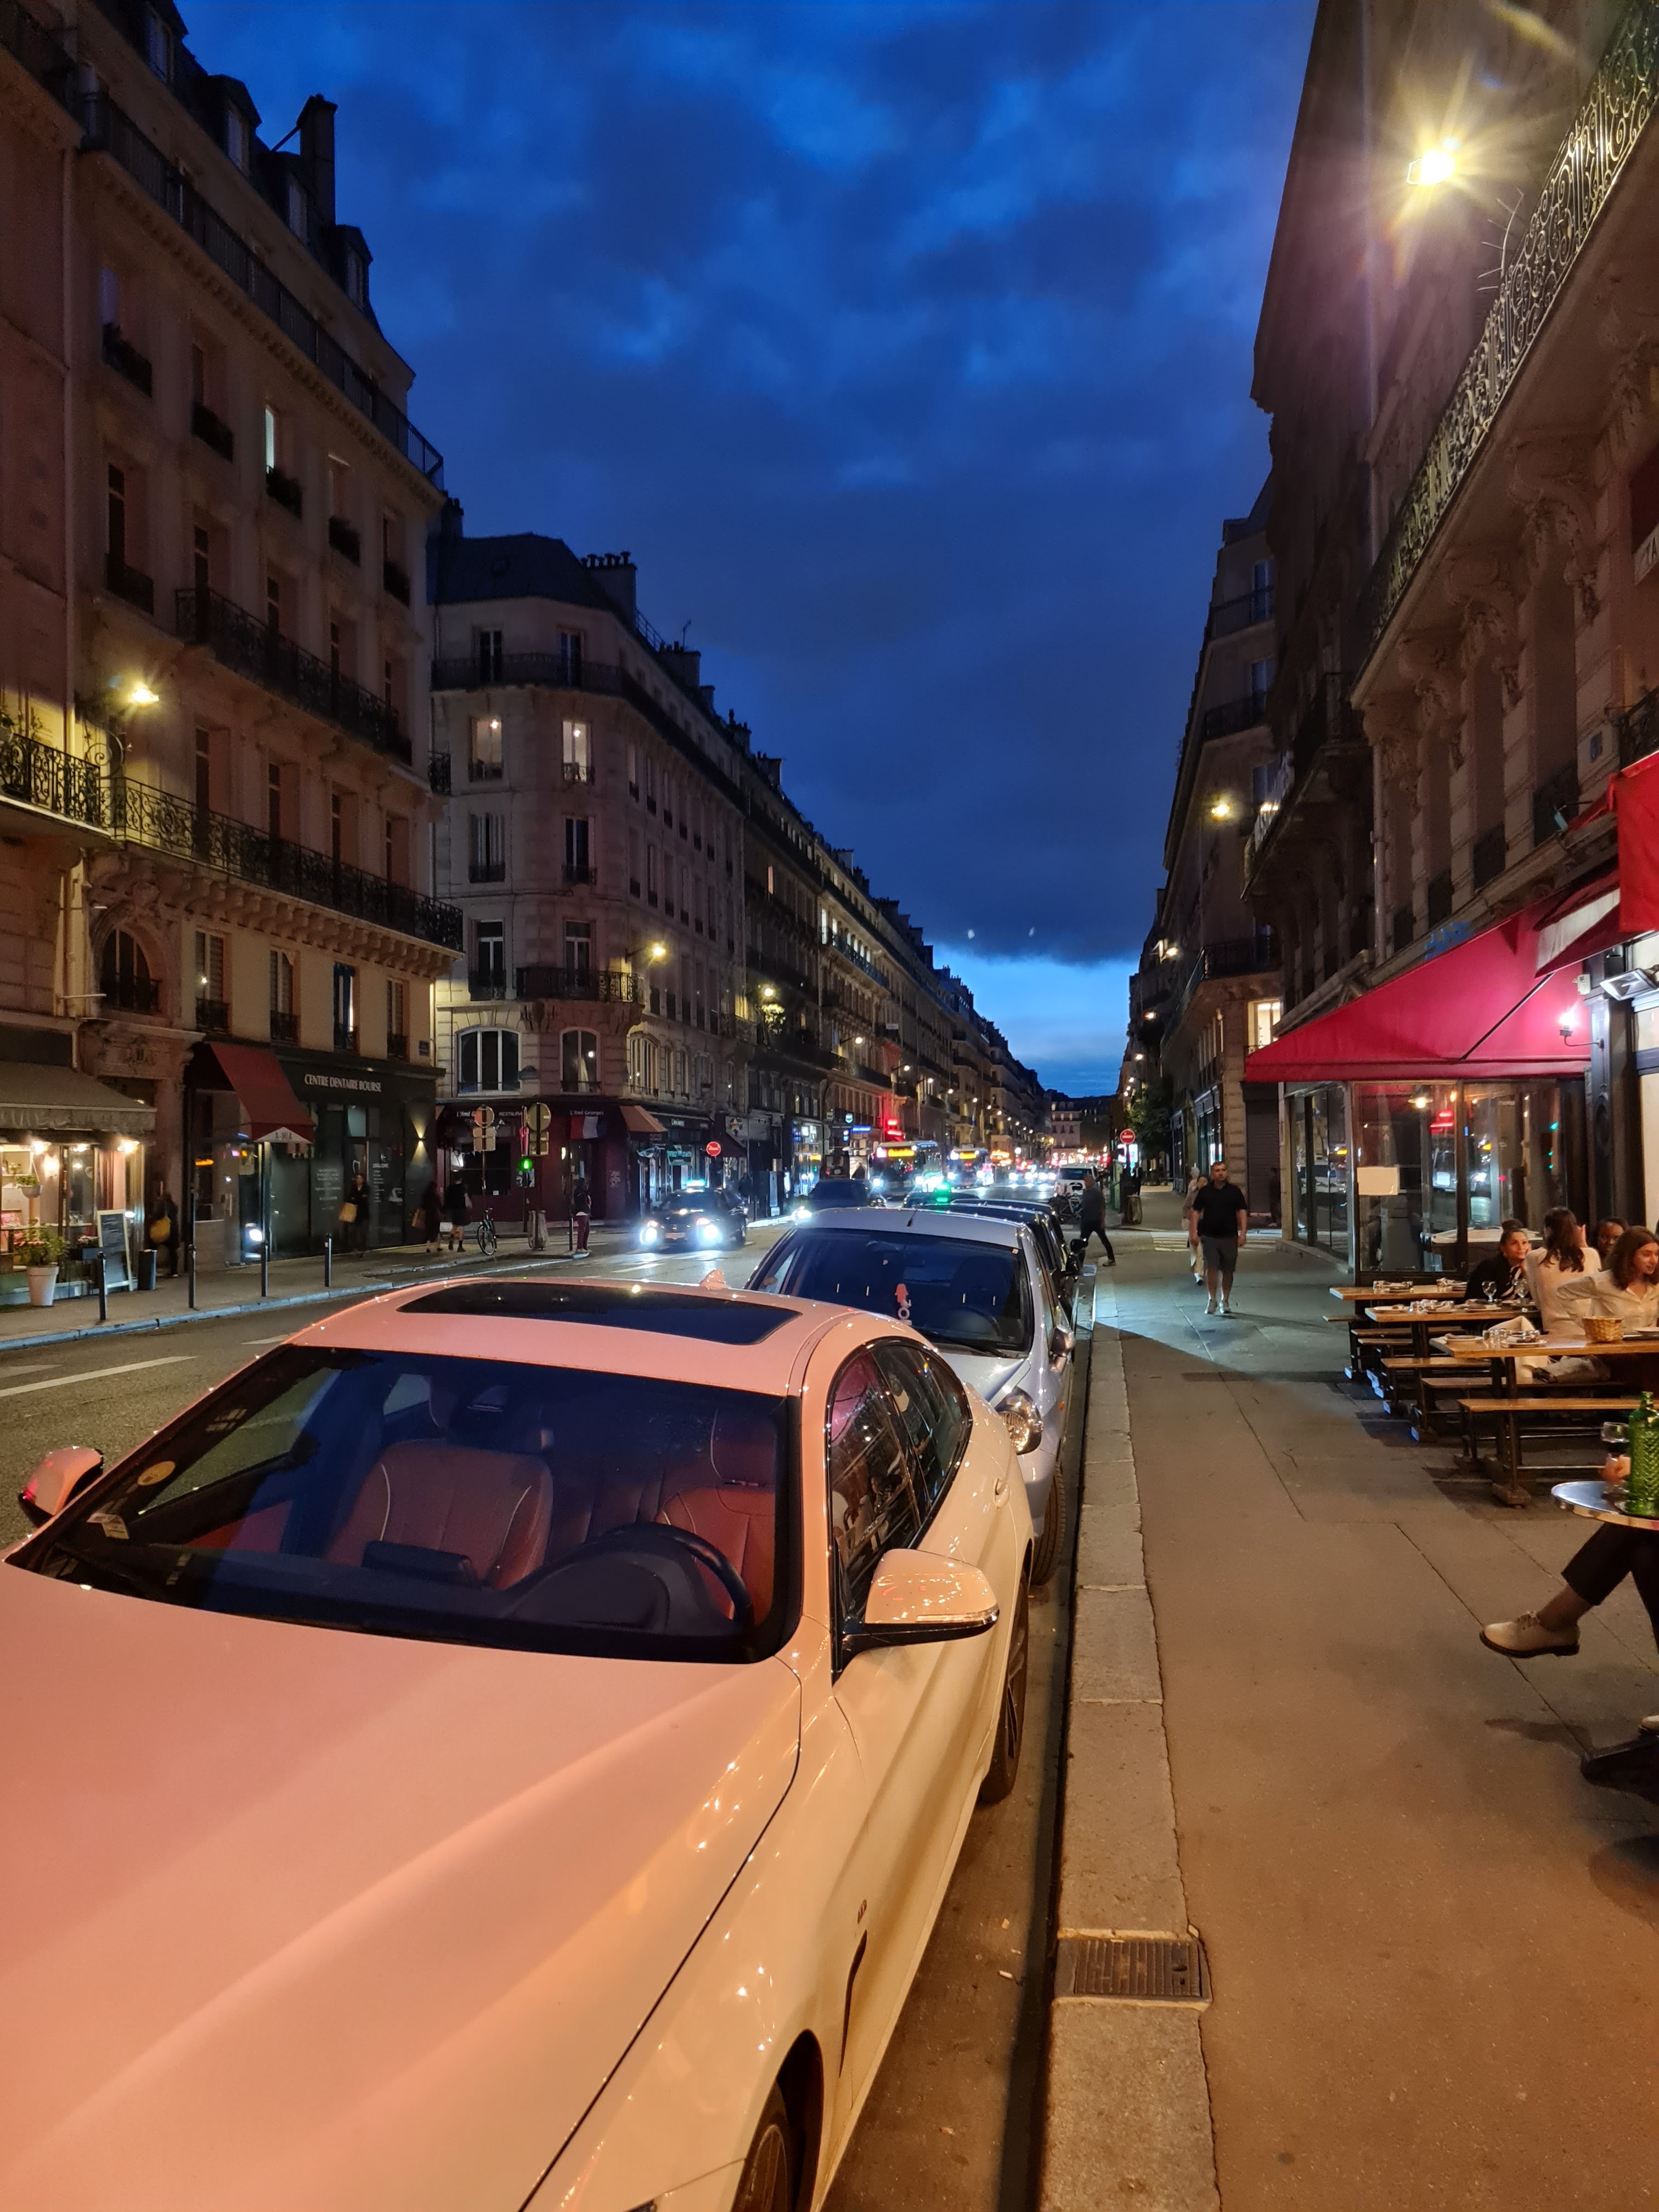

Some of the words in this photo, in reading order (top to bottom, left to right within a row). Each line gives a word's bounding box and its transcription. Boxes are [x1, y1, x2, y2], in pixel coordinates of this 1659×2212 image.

[304, 1074, 329, 1086] CENTRE
[330, 1077, 358, 1090] DENTAIRE
[359, 1081, 382, 1092] BOURSE
